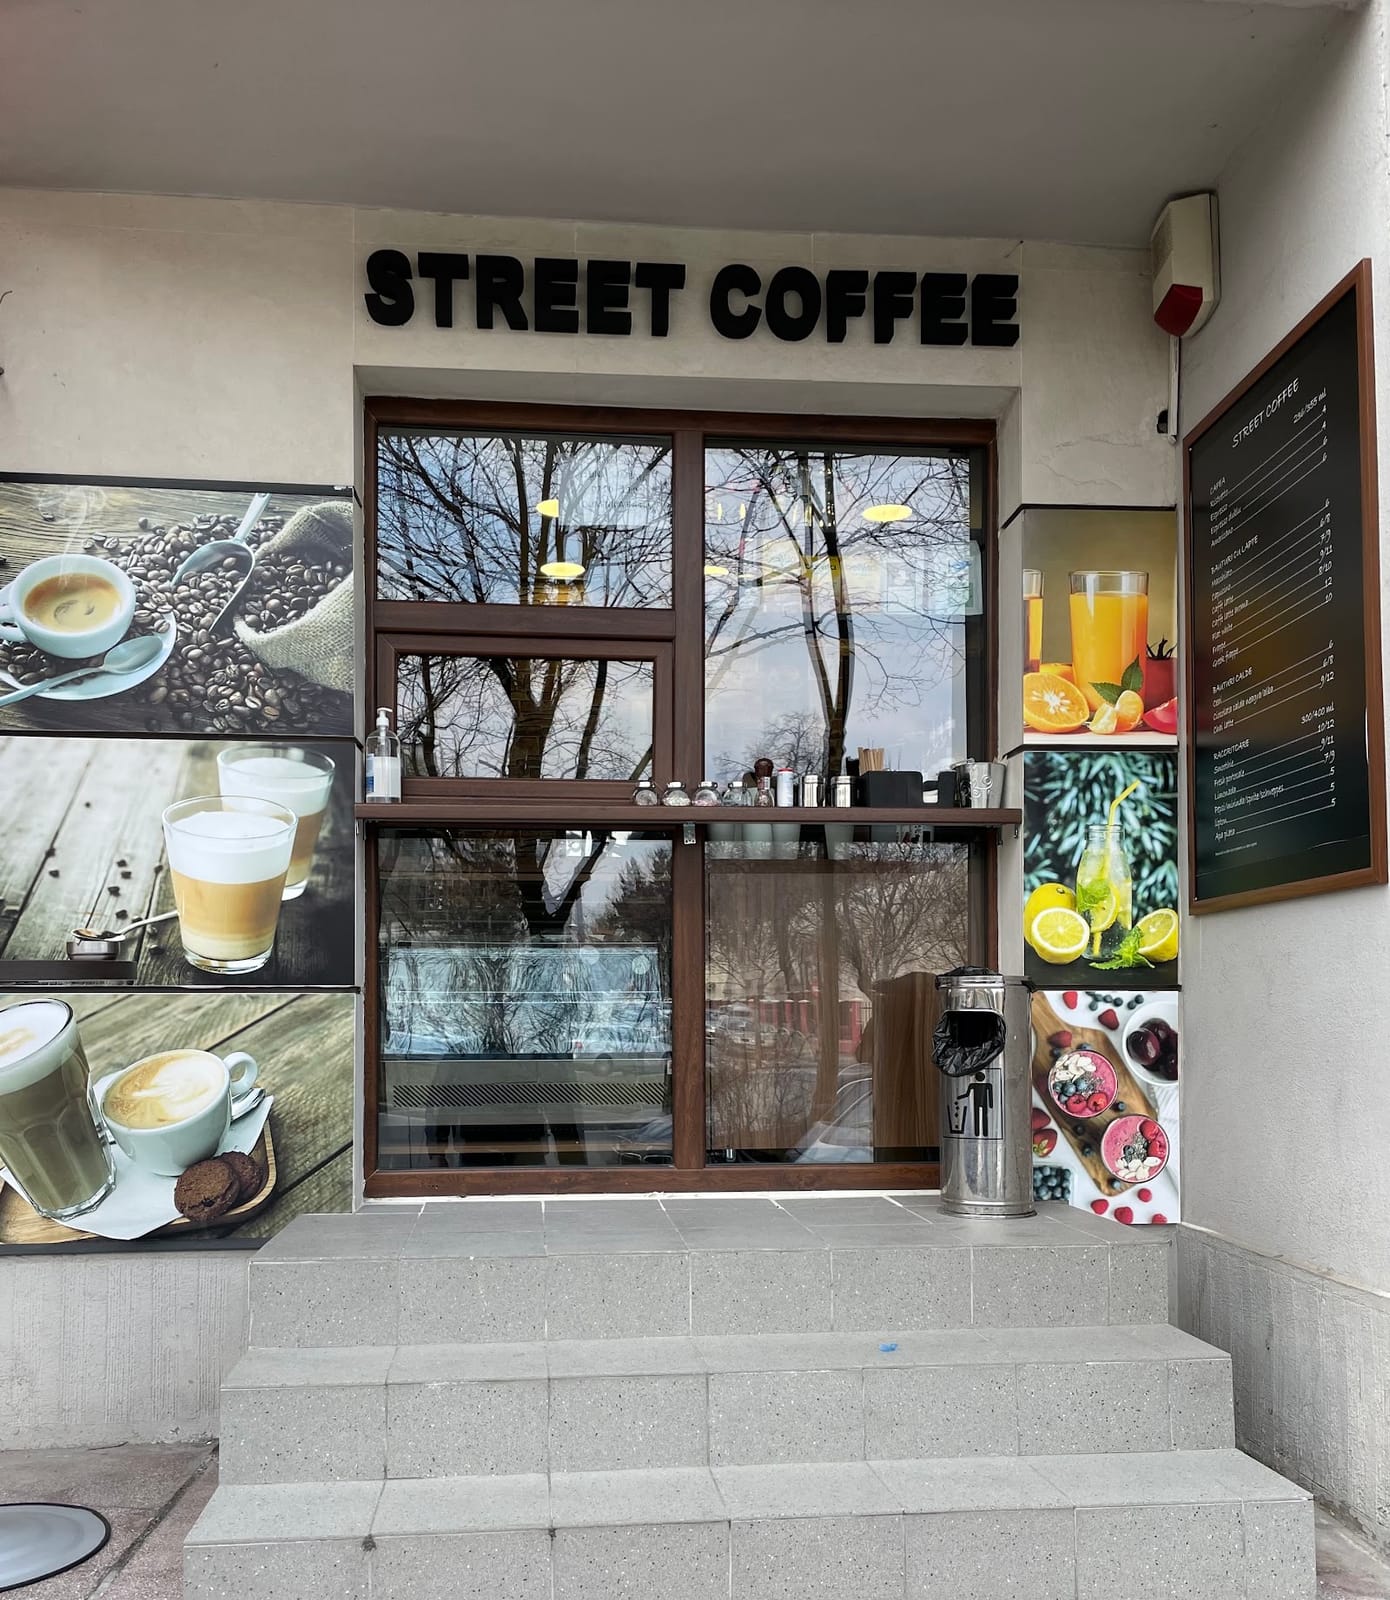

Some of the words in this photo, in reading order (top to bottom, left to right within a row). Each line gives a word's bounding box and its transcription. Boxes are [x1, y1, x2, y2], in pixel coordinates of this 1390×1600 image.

[364, 249, 686, 337] STREET
[709, 263, 1020, 347] COFFEE
[1318, 387, 1326, 401] ml
[1232, 410, 1265, 448] STREET
[1266, 377, 1298, 418] COFFEE
[1210, 504, 1228, 522] Espresso
[1210, 517, 1228, 535] Espresso
[1242, 535, 1258, 552] LAPTE
[1320, 528, 1331, 545] 7/9
[1319, 544, 1332, 564] 9/11
[1319, 561, 1332, 575] 8/10
[1325, 577, 1332, 587] 12
[1326, 592, 1332, 602] 10
[1235, 666, 1252, 682] CALDE
[1320, 672, 1334, 688] 9/12
[1301, 706, 1325, 724] 300/400
[1326, 701, 1334, 713] ml
[1318, 719, 1334, 732] 10/12
[1320, 736, 1334, 752] 9/11
[1214, 786, 1236, 800] Limonada
[1324, 750, 1335, 764] 7/9
[1330, 766, 1335, 775] 5
[1330, 782, 1335, 791] 5
[1331, 798, 1336, 806] 5
